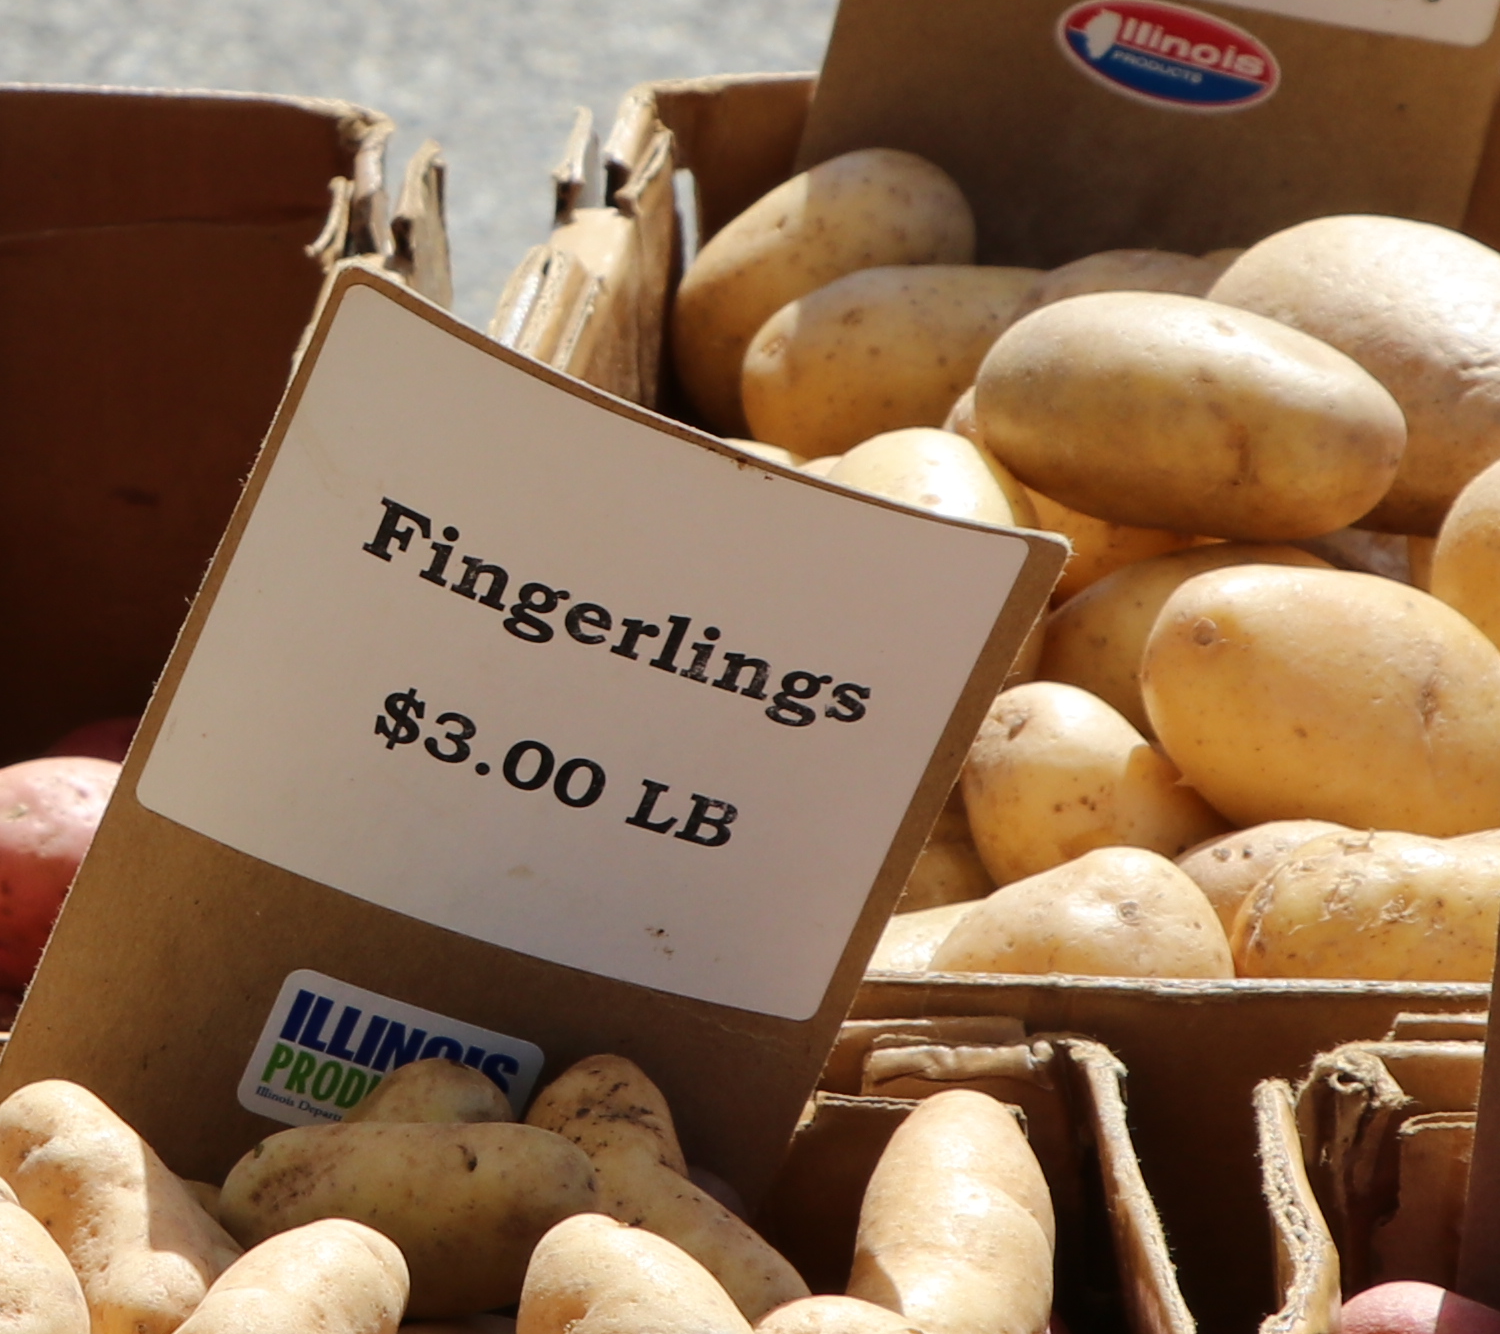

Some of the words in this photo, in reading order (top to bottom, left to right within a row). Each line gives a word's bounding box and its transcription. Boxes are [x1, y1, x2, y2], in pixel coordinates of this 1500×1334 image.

[1111, 49, 1204, 85] PRODUCTS
[362, 496, 873, 727] Fingerlings
[374, 687, 606, 809] $3.00
[624, 778, 738, 847] LB
[255, 1085, 295, 1107] Illinois
